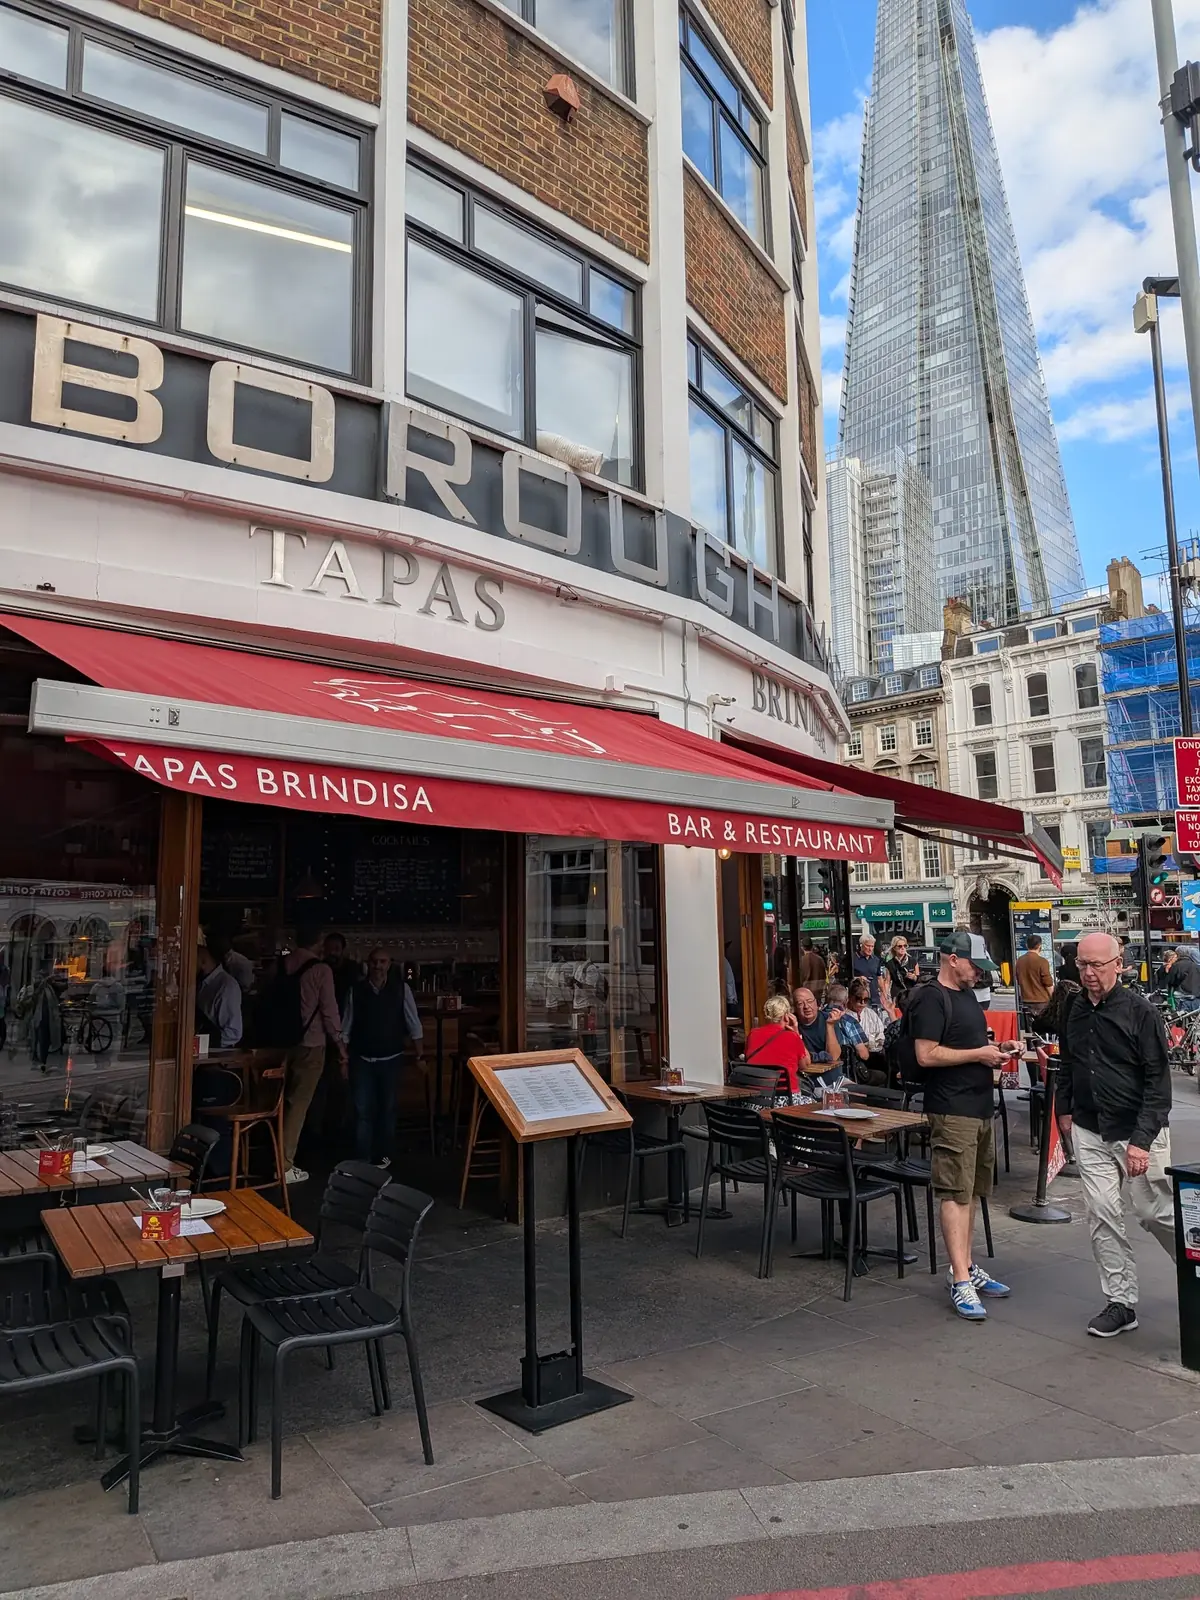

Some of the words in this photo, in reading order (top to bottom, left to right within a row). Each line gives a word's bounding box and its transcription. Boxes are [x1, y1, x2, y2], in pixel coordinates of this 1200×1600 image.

[30, 313, 780, 643] BOROUGH
[248, 524, 507, 632] TAPAS
[257, 767, 434, 813] BRINDISA
[1186, 794, 1200, 802] MO
[668, 813, 715, 839] BAR
[723, 820, 737, 841] &
[745, 821, 875, 855] RESTAURANT
[1179, 814, 1198, 822] NEW
[1188, 840, 1200, 848] TO
